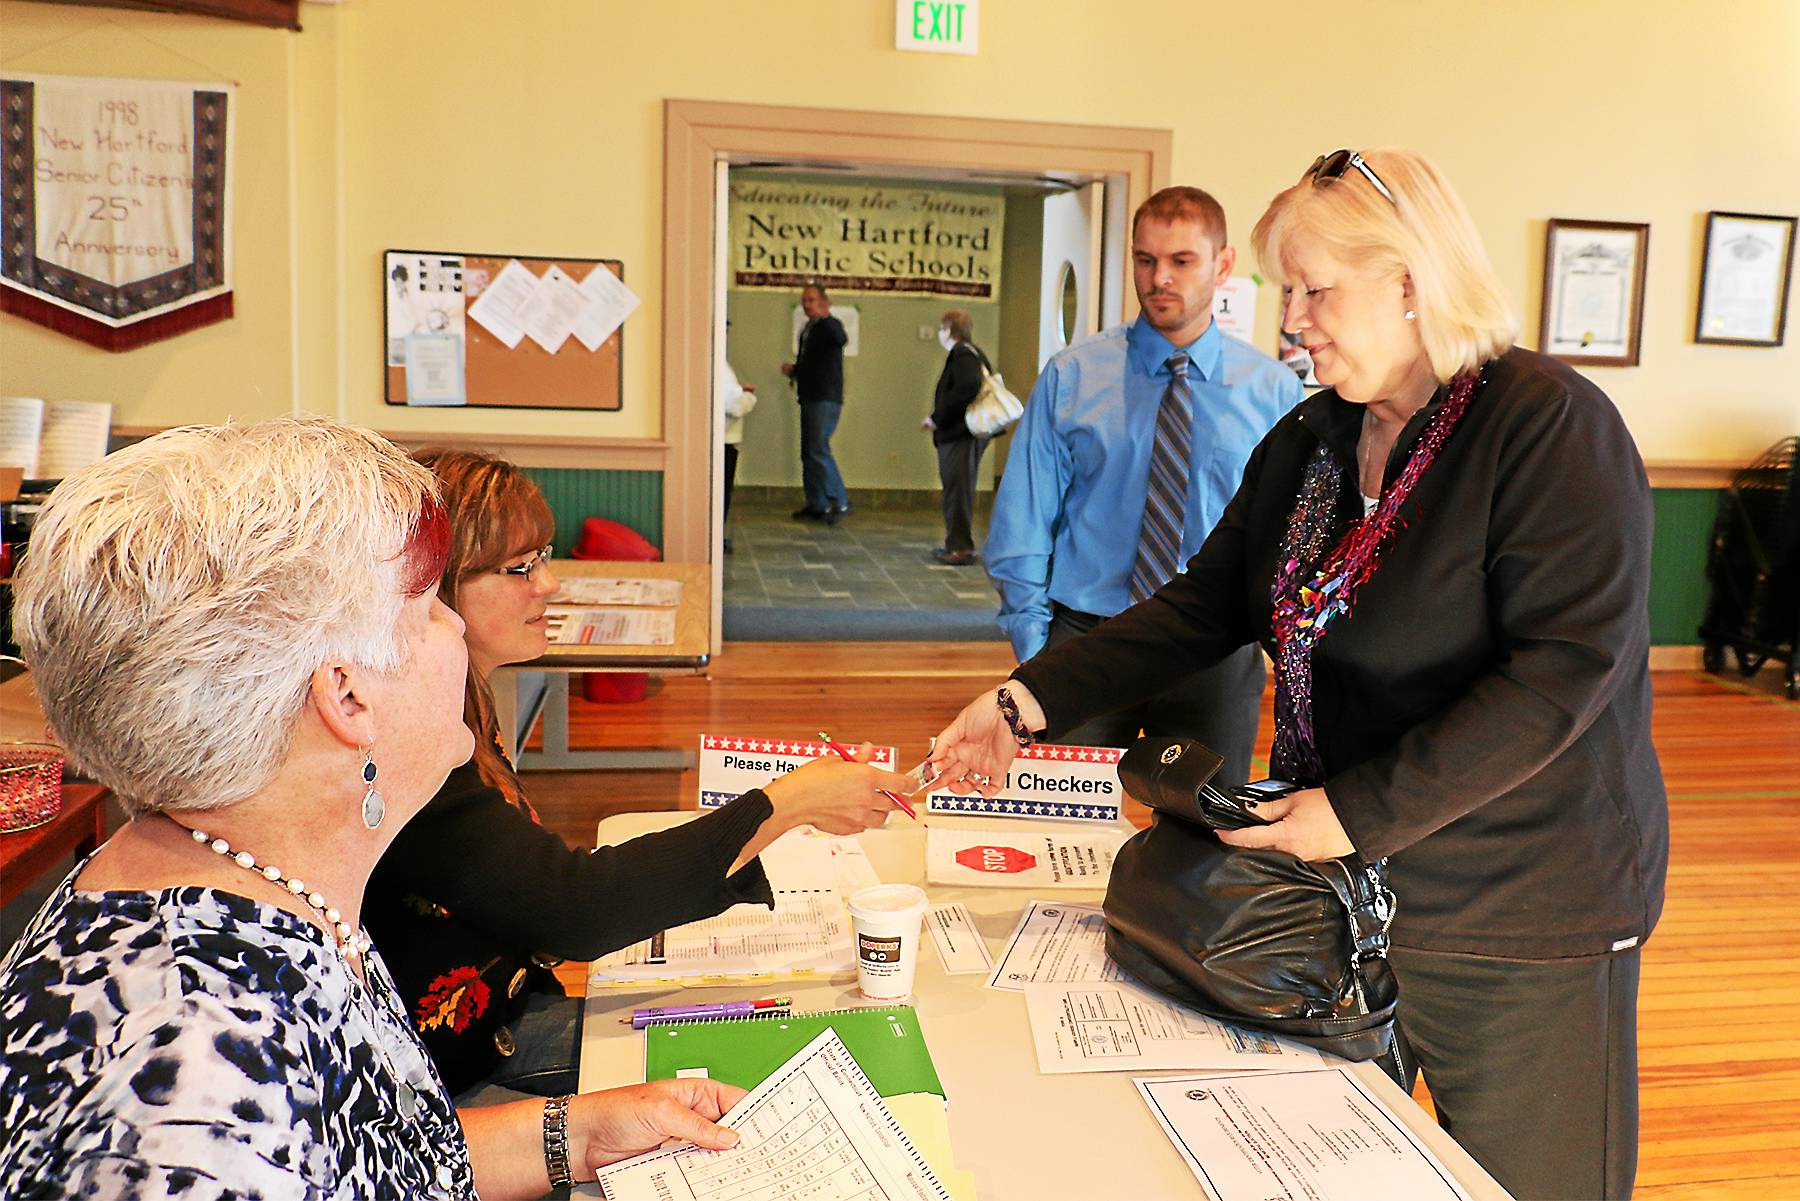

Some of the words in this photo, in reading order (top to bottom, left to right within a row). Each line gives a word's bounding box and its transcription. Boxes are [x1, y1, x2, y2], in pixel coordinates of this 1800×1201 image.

[913, 0, 966, 42] EXIT
[99, 102, 140, 125] 1998
[40, 127, 84, 151] New
[94, 130, 189, 155] Hartford
[36, 158, 100, 183] Senior
[859, 191, 898, 210] the
[911, 193, 991, 217] Future
[747, 214, 822, 240] New
[841, 218, 990, 251] Hartford
[54, 231, 179, 263] Anniversary
[743, 244, 852, 272] Public
[868, 249, 991, 280] Schools
[1220, 299, 1231, 313] 1
[724, 756, 771, 771] Please
[776, 760, 799, 772] Ha
[1018, 773, 1113, 793] Checkers
[983, 848, 1007, 871] STOP
